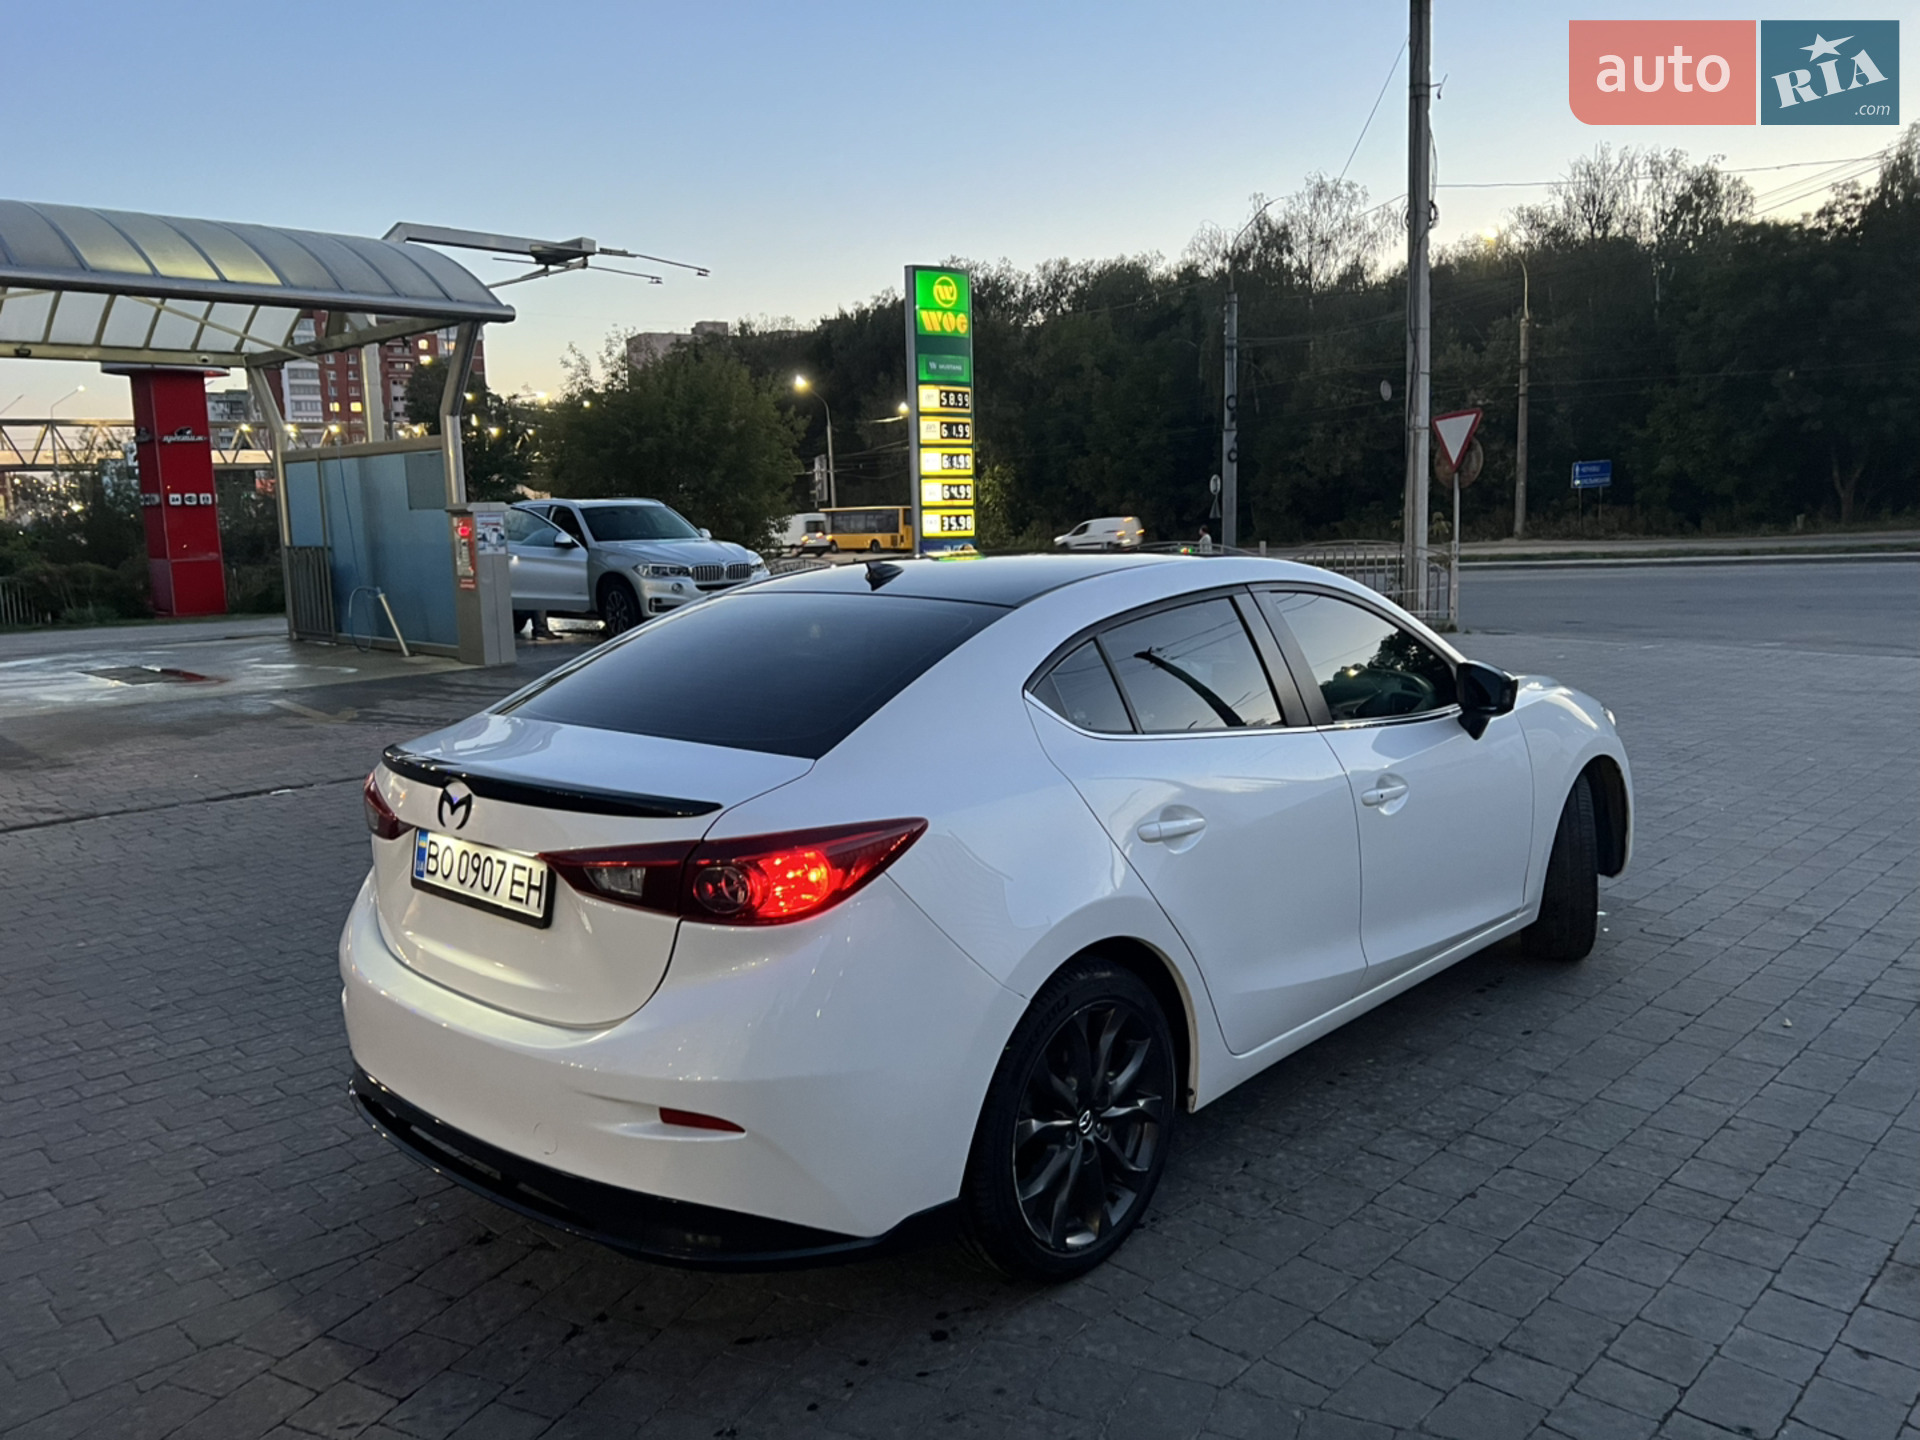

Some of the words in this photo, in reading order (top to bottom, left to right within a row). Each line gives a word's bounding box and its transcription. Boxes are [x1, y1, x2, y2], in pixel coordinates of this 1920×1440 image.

[920, 309, 968, 334] WOG
[426, 840, 454, 880] BO
[457, 849, 507, 897] 0907
[509, 864, 544, 909] EH
